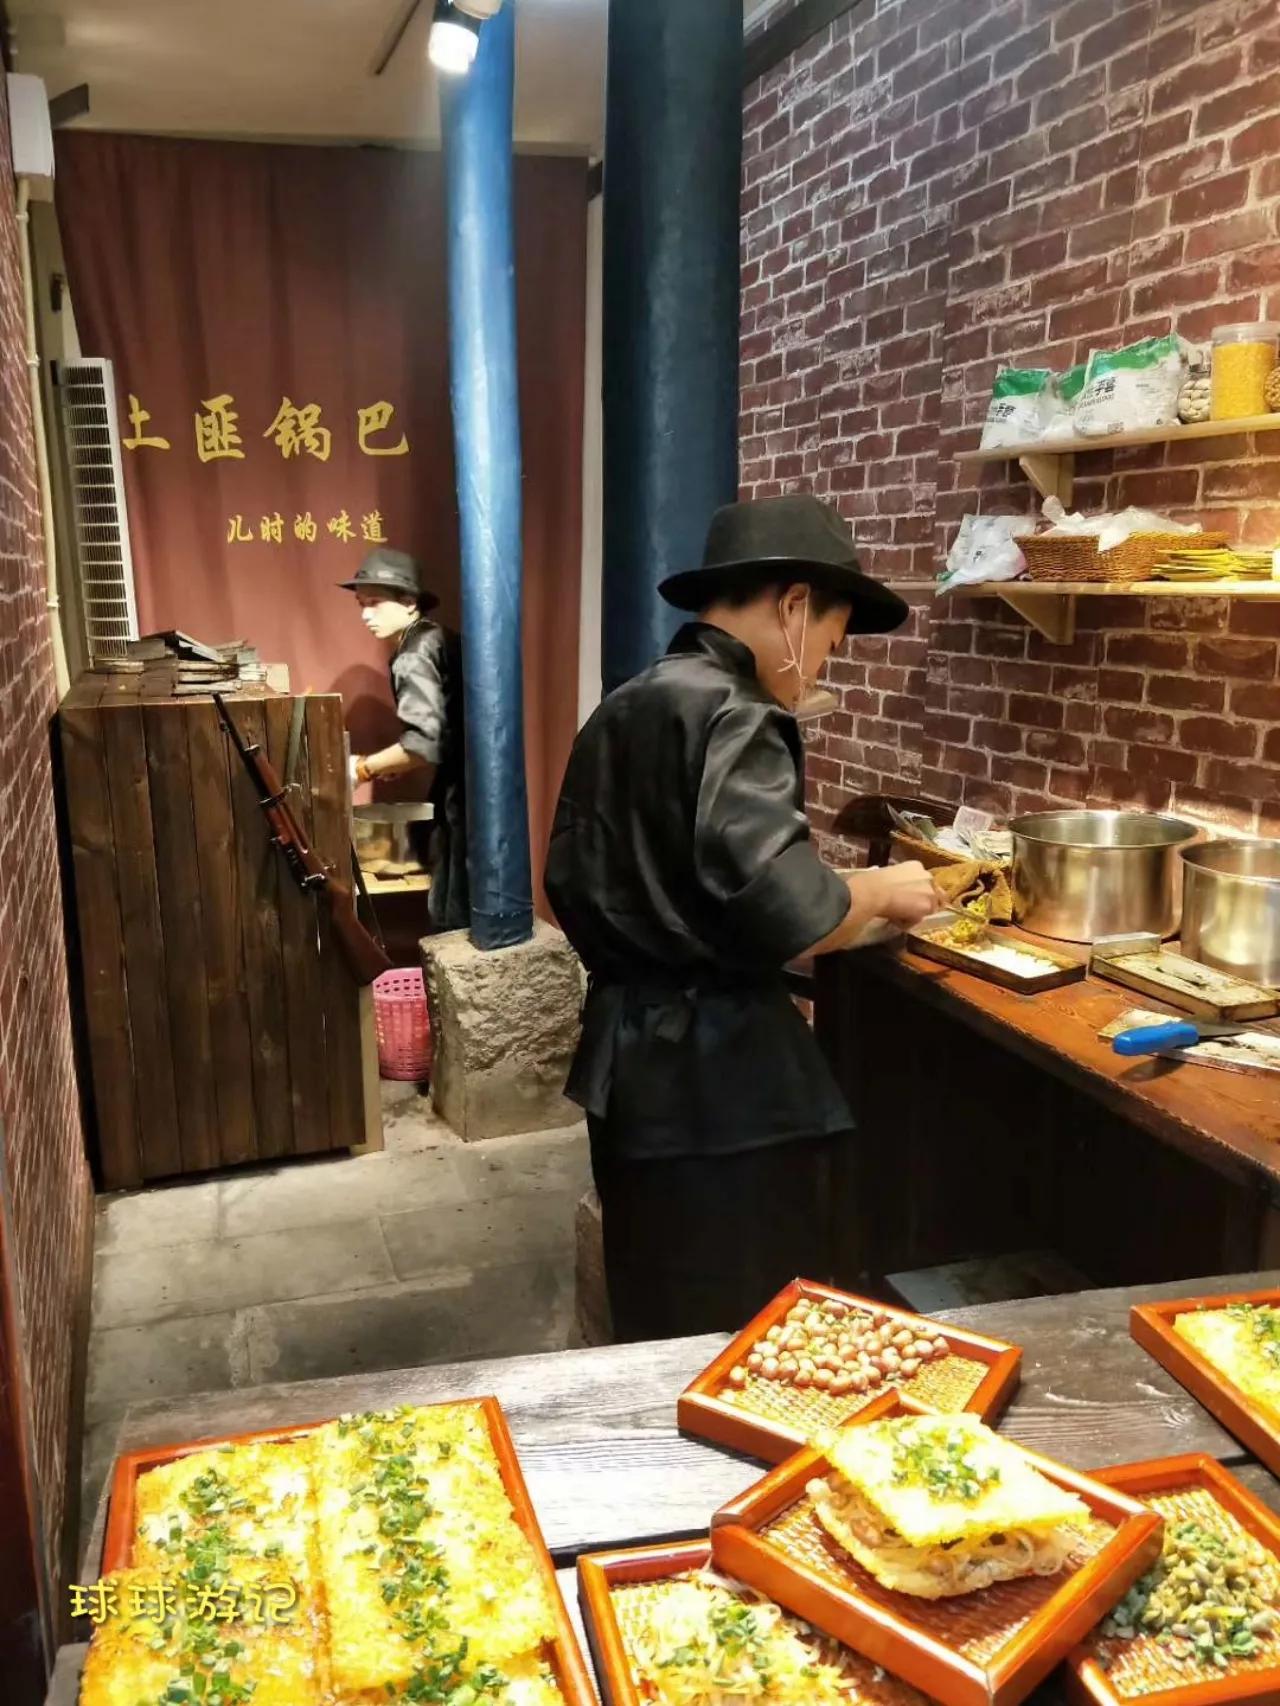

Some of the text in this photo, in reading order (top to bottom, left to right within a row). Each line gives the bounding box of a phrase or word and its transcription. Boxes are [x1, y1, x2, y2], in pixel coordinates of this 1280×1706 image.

[122, 393, 410, 463] 土匪锅巴
[226, 509, 389, 544] 儿时的味道
